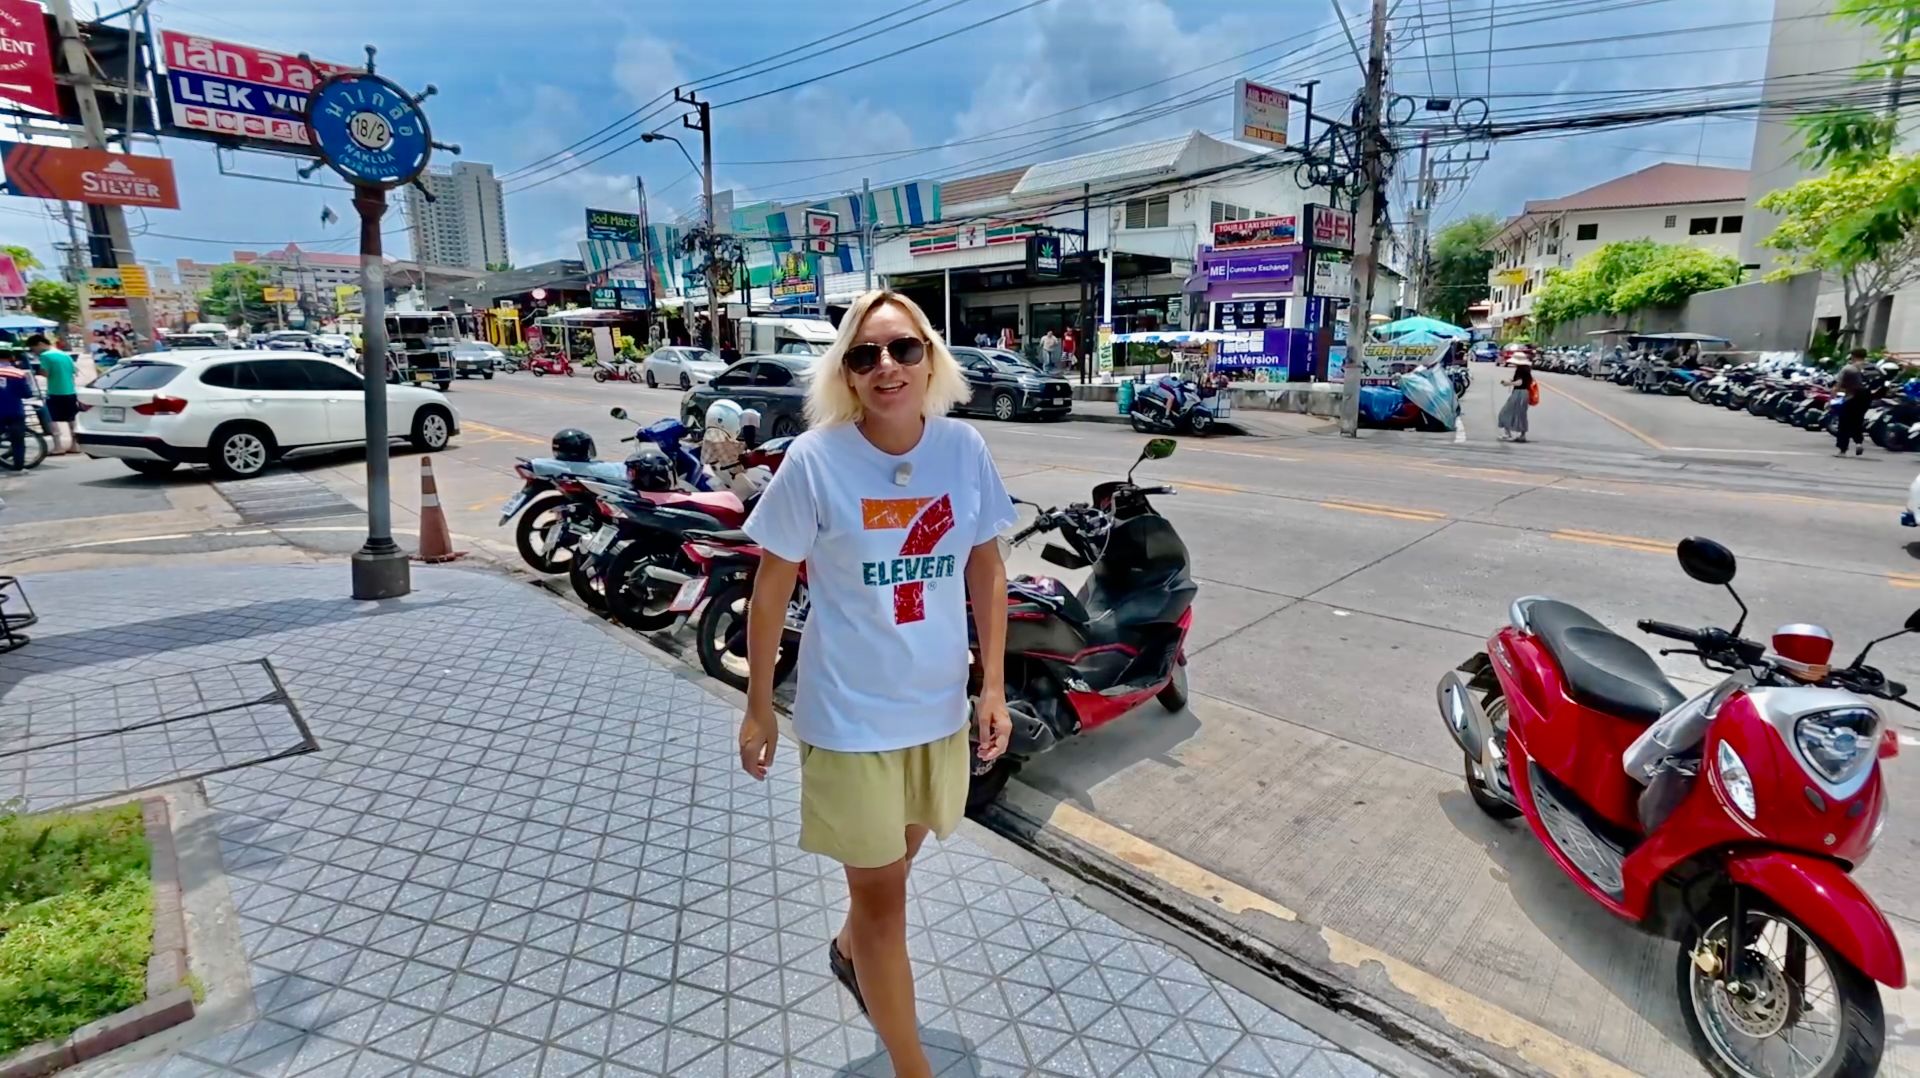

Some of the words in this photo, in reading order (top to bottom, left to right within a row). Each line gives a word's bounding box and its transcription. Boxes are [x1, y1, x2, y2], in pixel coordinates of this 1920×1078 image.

[0, 38, 36, 56] ENT
[172, 36, 248, 79] เล็ก
[257, 52, 321, 90] วิล
[178, 76, 255, 111] LEK
[1261, 91, 1288, 109] TICKET
[355, 117, 386, 143] 18/2
[344, 143, 396, 165] NAKLUA
[81, 170, 161, 198] SILVER
[591, 213, 608, 225] Jod
[610, 215, 638, 227] Mars
[1219, 223, 1238, 232] TOUR
[1244, 221, 1259, 230] TAXI
[1260, 218, 1291, 228] SERVICE
[1209, 265, 1226, 277] ME
[1229, 265, 1257, 274] Currency
[1258, 263, 1289, 273] Exchange
[1216, 354, 1238, 365] Best
[1240, 354, 1279, 365] Version
[1395, 345, 1438, 356] RENT
[860, 492, 955, 626] 7
